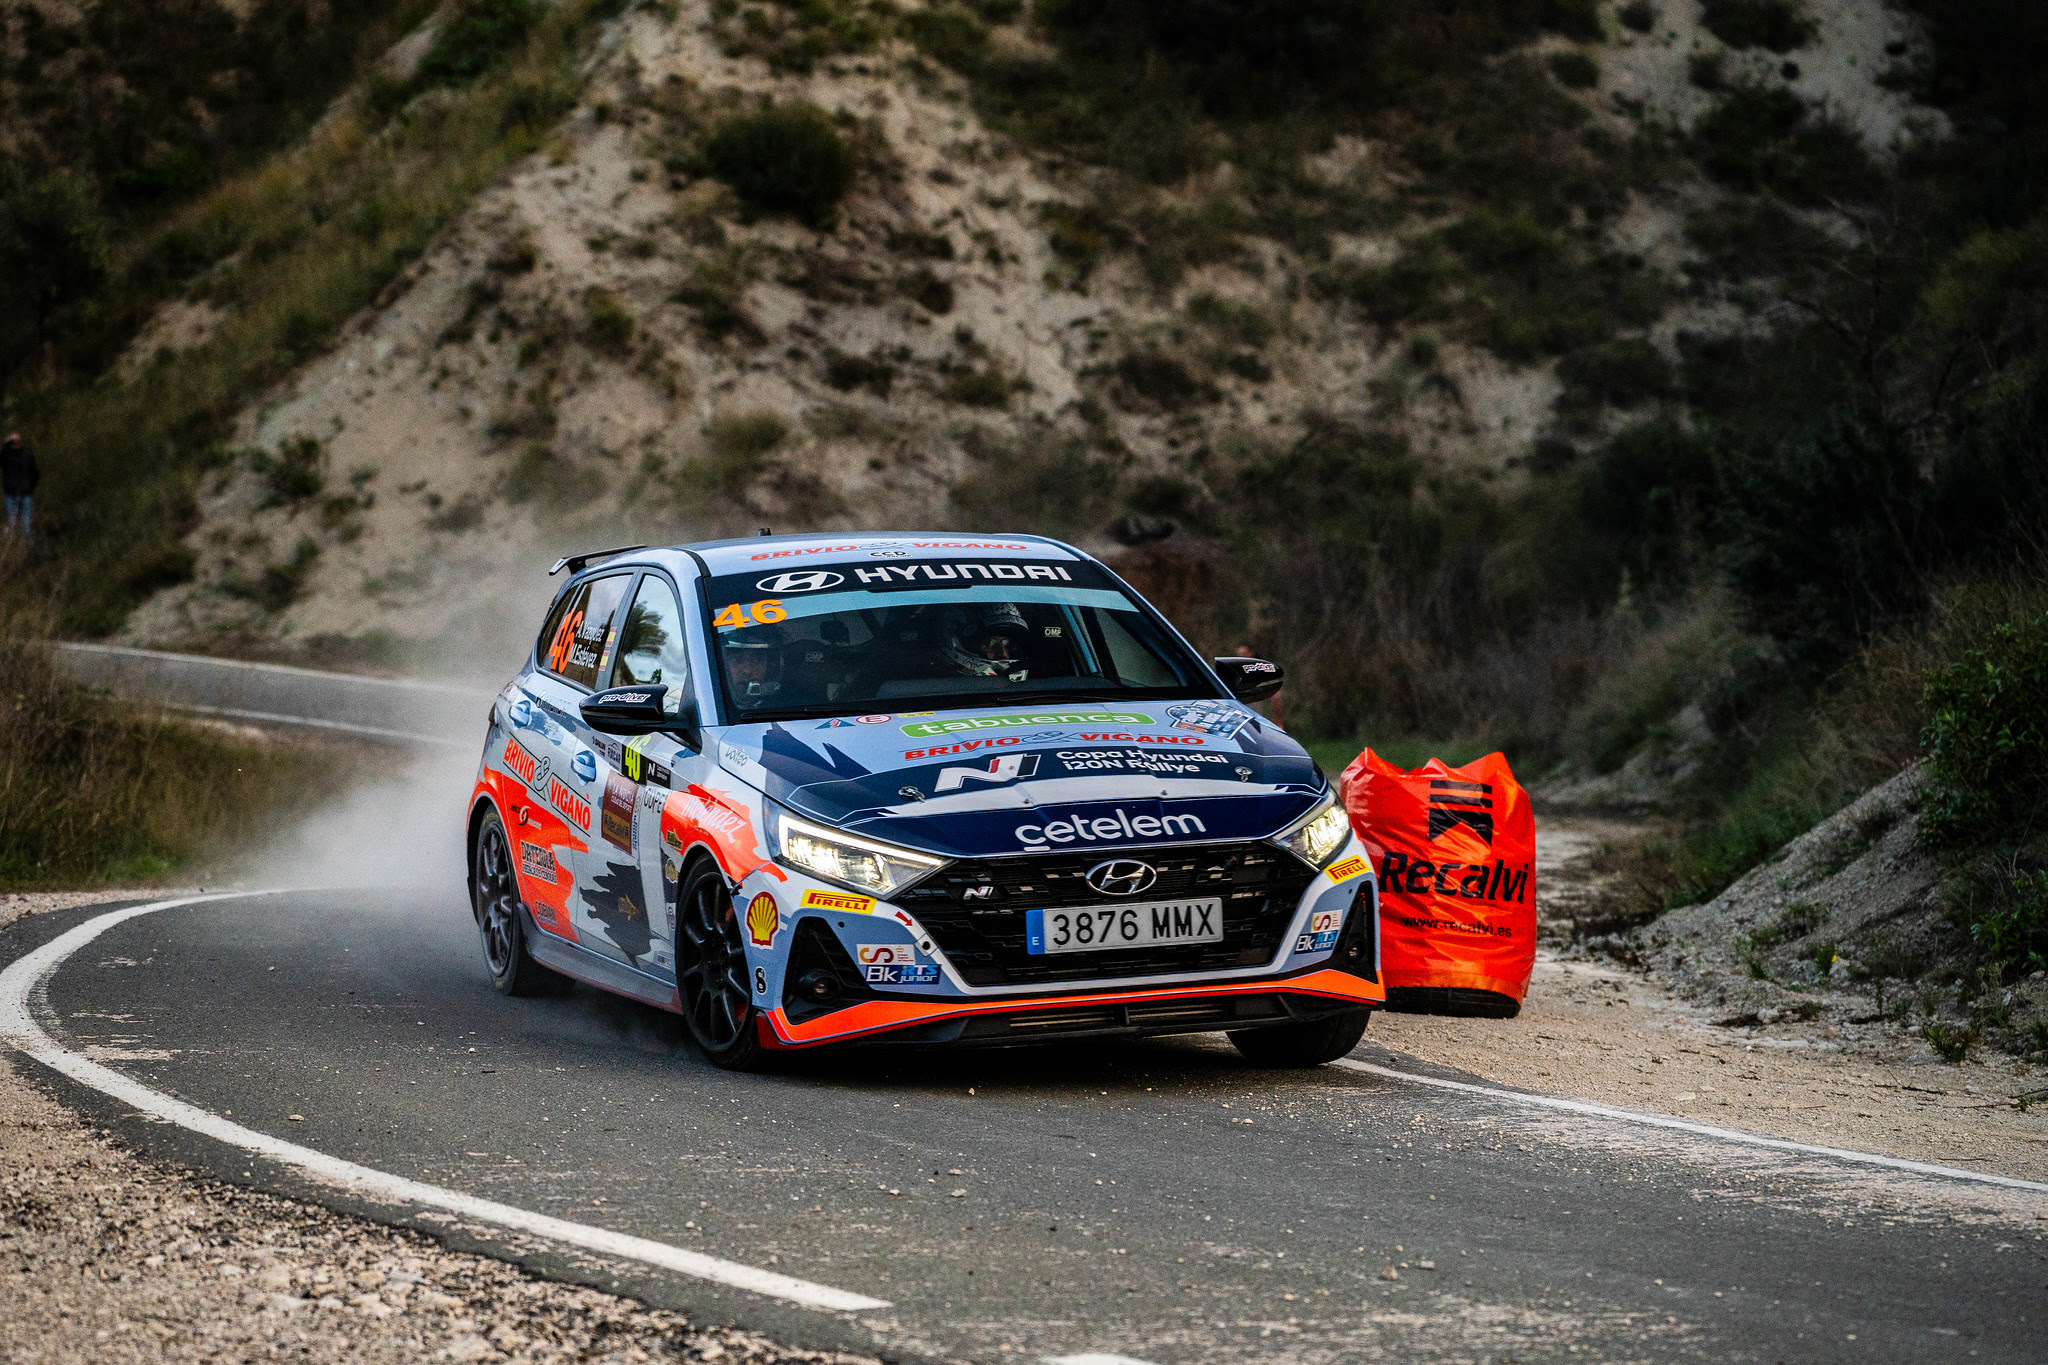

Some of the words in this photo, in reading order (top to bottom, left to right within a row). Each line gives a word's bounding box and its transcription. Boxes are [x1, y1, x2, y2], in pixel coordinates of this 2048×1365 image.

[751, 545, 857, 560] BRIVIO
[854, 565, 1072, 583] HYUNDAI
[713, 599, 787, 629] 46
[1044, 628, 1062, 636] OMP
[549, 610, 583, 674] 46
[917, 713, 1139, 734] tabuenca
[905, 738, 1020, 760] BRIVIO
[1080, 733, 1204, 745] VIGANÒ
[625, 734, 652, 781] 46
[1056, 750, 1124, 762] Copa
[1130, 750, 1229, 764] Hyundai
[1064, 759, 1125, 771] i20N
[1127, 759, 1200, 773] Rallye
[504, 739, 535, 784] BRIVIO
[551, 778, 591, 831] VIGANÒ
[1015, 808, 1206, 850] cetelem
[1328, 858, 1366, 880] PIRELLI
[1378, 851, 1529, 904] Recalvi
[808, 893, 870, 910] PIRELLI
[1053, 909, 1139, 946] 3876
[1152, 904, 1215, 939] MMX
[1400, 915, 1512, 938] www.recalvi.es
[1032, 936, 1039, 945] E
[1295, 935, 1315, 951] Bk
[866, 966, 898, 981] Bk
[901, 965, 938, 975] RTS
[897, 976, 937, 984] junior
